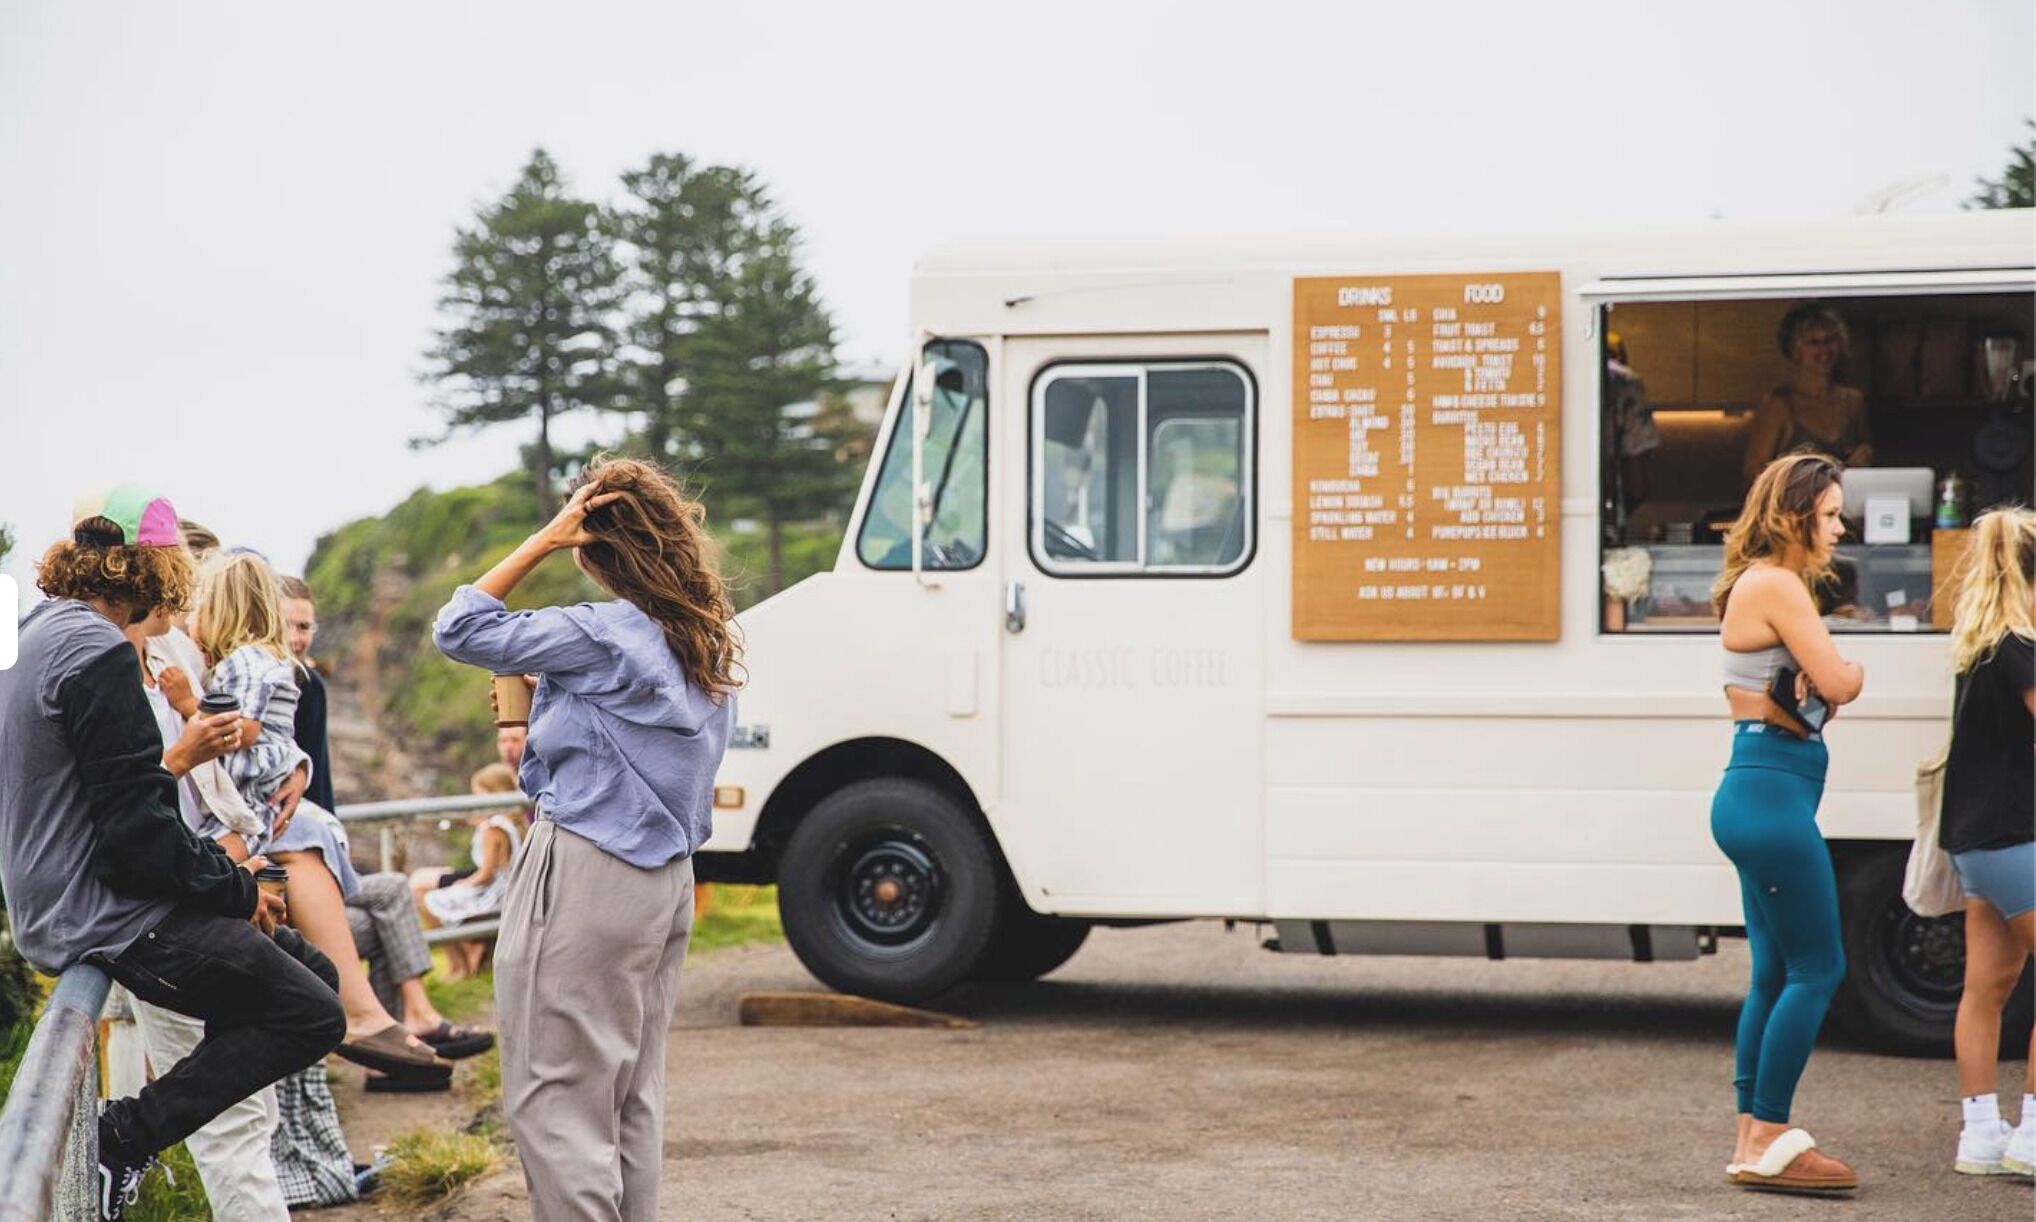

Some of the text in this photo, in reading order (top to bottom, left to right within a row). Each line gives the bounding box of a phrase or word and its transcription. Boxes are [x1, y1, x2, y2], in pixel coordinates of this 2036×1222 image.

[1338, 287, 1391, 305] DRINKS
[1464, 283, 1504, 303] FOOD
[1310, 325, 1360, 339] ESPRESSO
[1433, 322, 1461, 336] FRUIT
[1464, 322, 1495, 336] TOAST
[1310, 341, 1347, 355] COFFEE
[1432, 339, 1463, 352] TOAST
[1475, 338, 1519, 351] SPREADS
[1482, 354, 1513, 367] TOAST
[1310, 480, 1360, 492] KOMBUCHA
[1310, 495, 1344, 508] LEMON
[1310, 511, 1363, 524] SPARKLING
[1365, 510, 1396, 524] WATER
[1310, 527, 1338, 540] STILL
[1341, 527, 1372, 540] WATER
[1364, 557, 1386, 571] NEW
[1396, 586, 1428, 599] ABOUT
[1039, 647, 1229, 689] CLASSIC COFFEE
